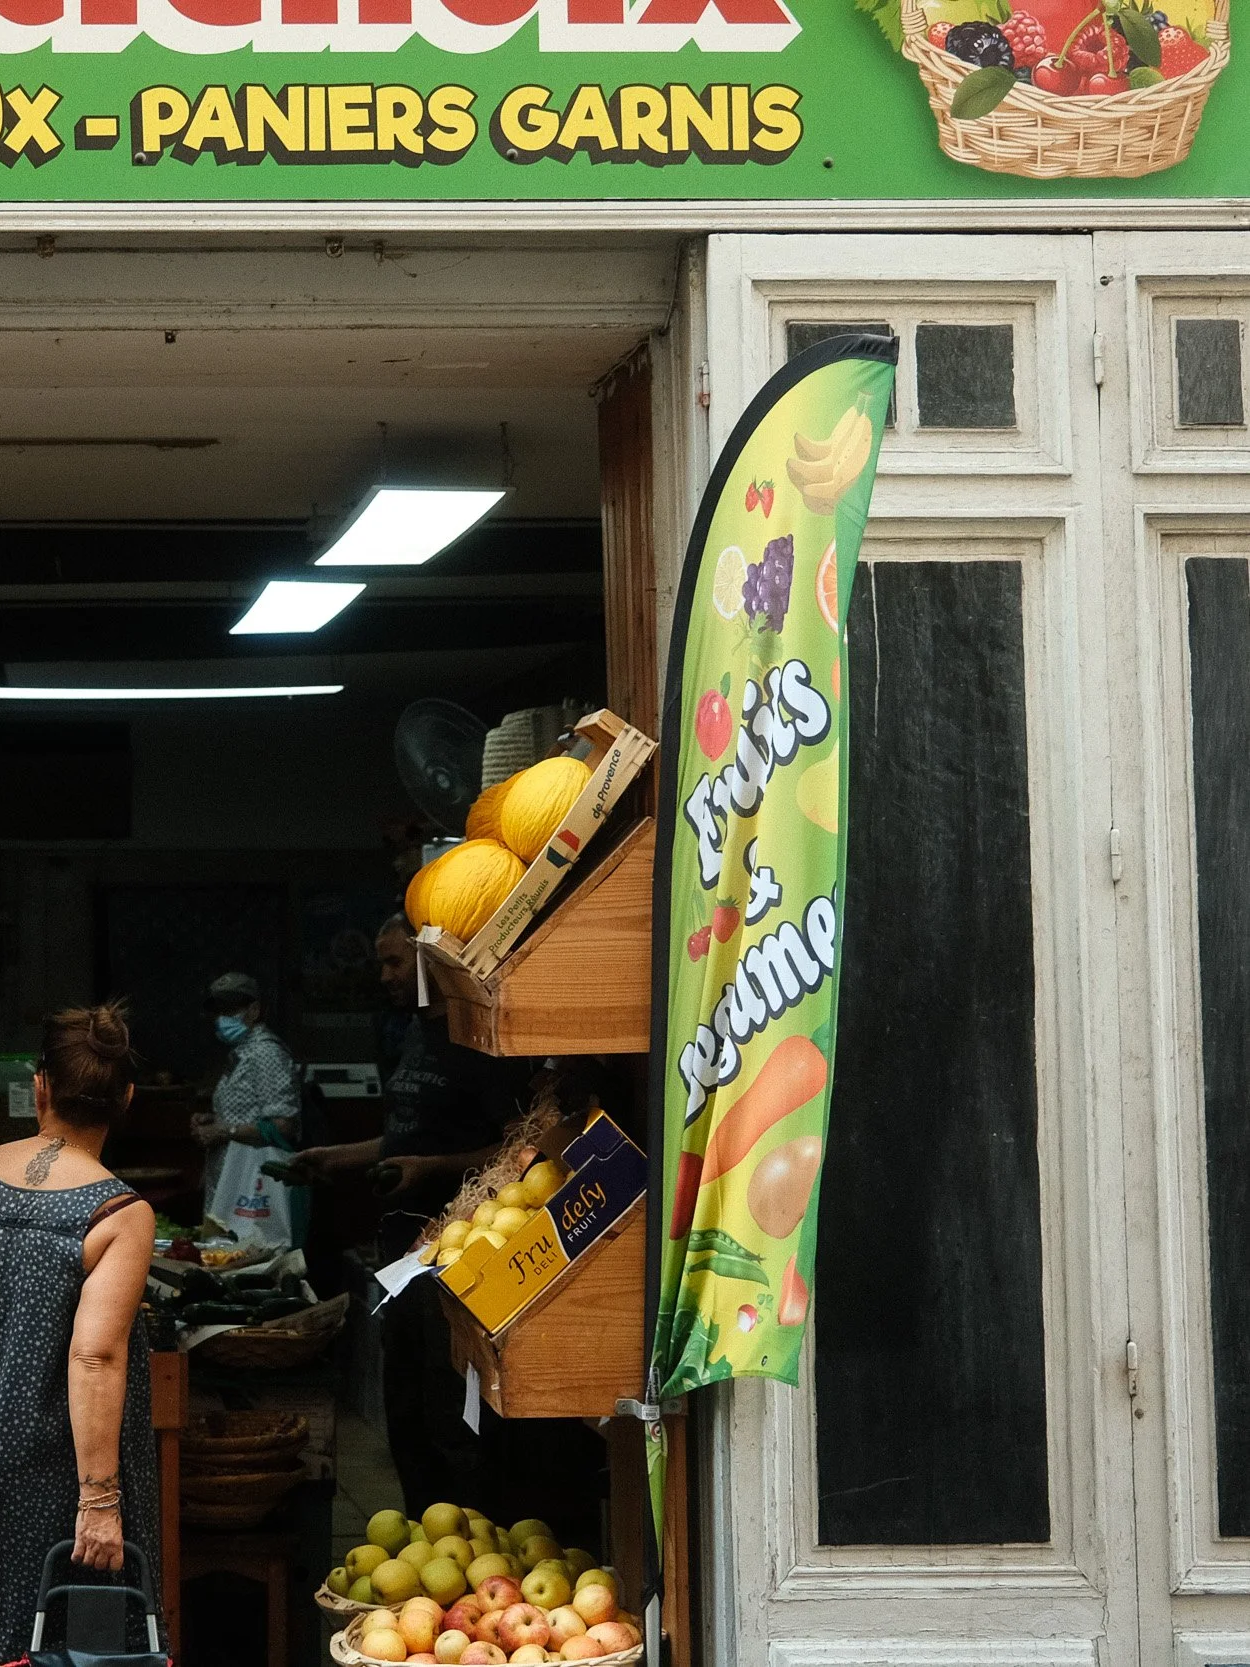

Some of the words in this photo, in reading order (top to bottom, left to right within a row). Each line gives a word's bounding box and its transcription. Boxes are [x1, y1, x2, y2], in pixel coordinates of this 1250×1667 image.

[129, 83, 477, 168] PANIERS
[490, 83, 803, 168] GARNIS
[597, 748, 622, 801] Provence
[683, 658, 832, 890] Fruits
[591, 800, 605, 820] de
[488, 904, 530, 953] Producteurs
[496, 913, 511, 930] Les
[508, 891, 529, 916] Petits
[561, 1182, 607, 1231] dely
[567, 1211, 597, 1243] FRUIT
[508, 1234, 554, 1286] Fru
[533, 1251, 558, 1276] DELI
